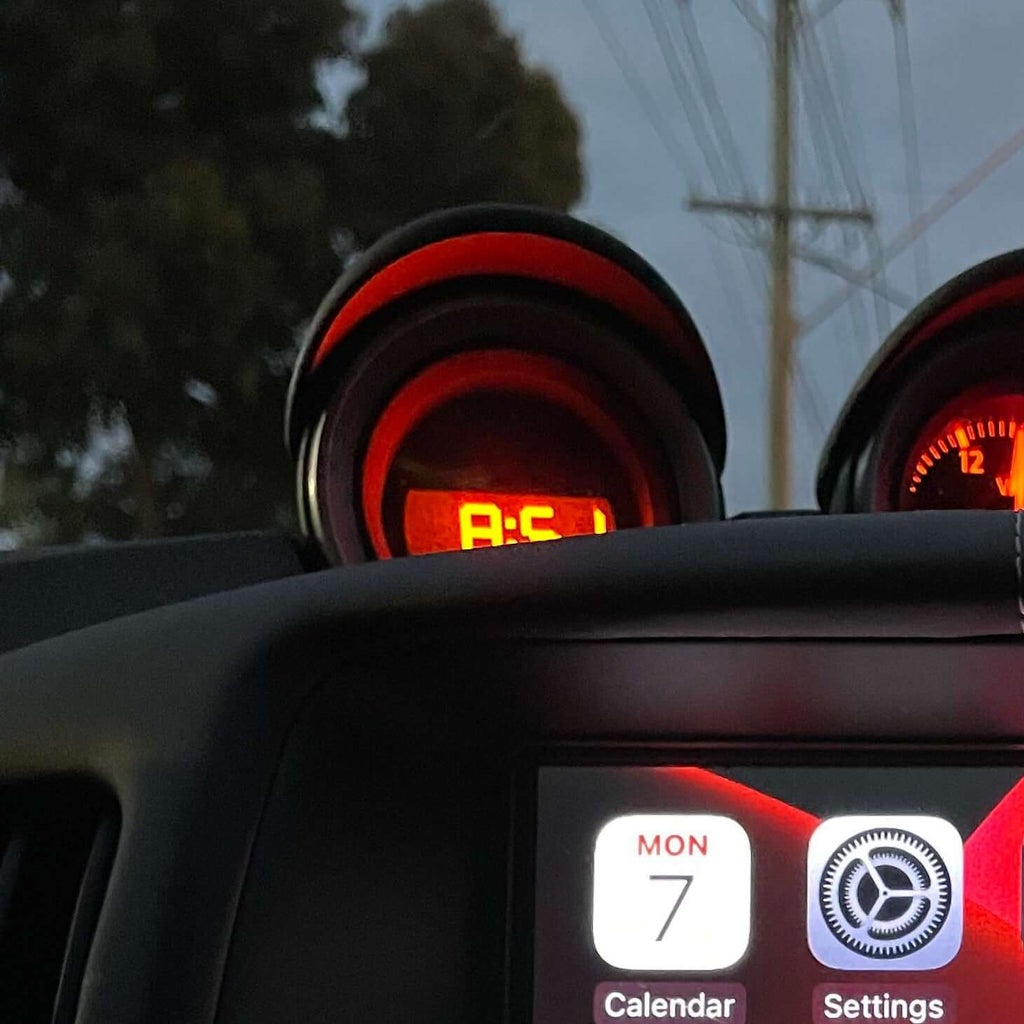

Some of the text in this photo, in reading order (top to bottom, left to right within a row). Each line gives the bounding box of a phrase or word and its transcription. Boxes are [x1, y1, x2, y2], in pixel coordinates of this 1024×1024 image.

[959, 451, 984, 474] 12
[638, 834, 708, 856] MON
[649, 875, 694, 942] 7
[604, 992, 736, 1019] Calendar
[823, 993, 944, 1024] Settings
